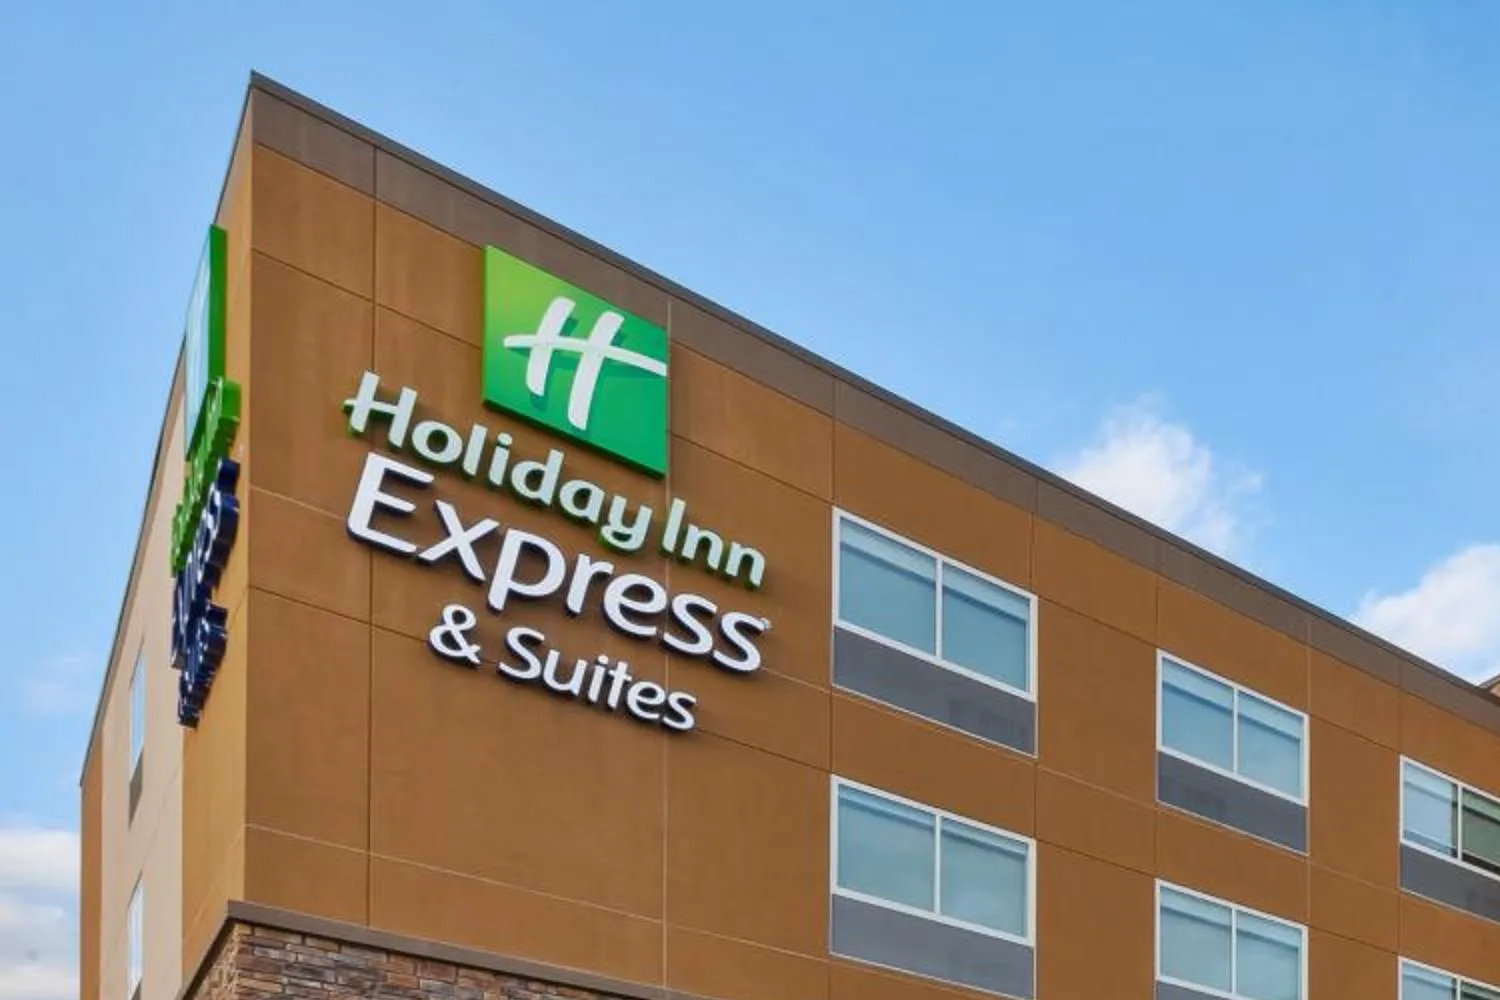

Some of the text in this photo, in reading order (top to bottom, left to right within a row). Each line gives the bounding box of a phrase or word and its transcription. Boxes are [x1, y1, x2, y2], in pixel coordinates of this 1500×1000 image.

[502, 295, 668, 431] H
[342, 370, 653, 553] Holiday
[661, 498, 767, 587] Inn
[346, 451, 768, 674] Express
[429, 603, 698, 732] & Suites
